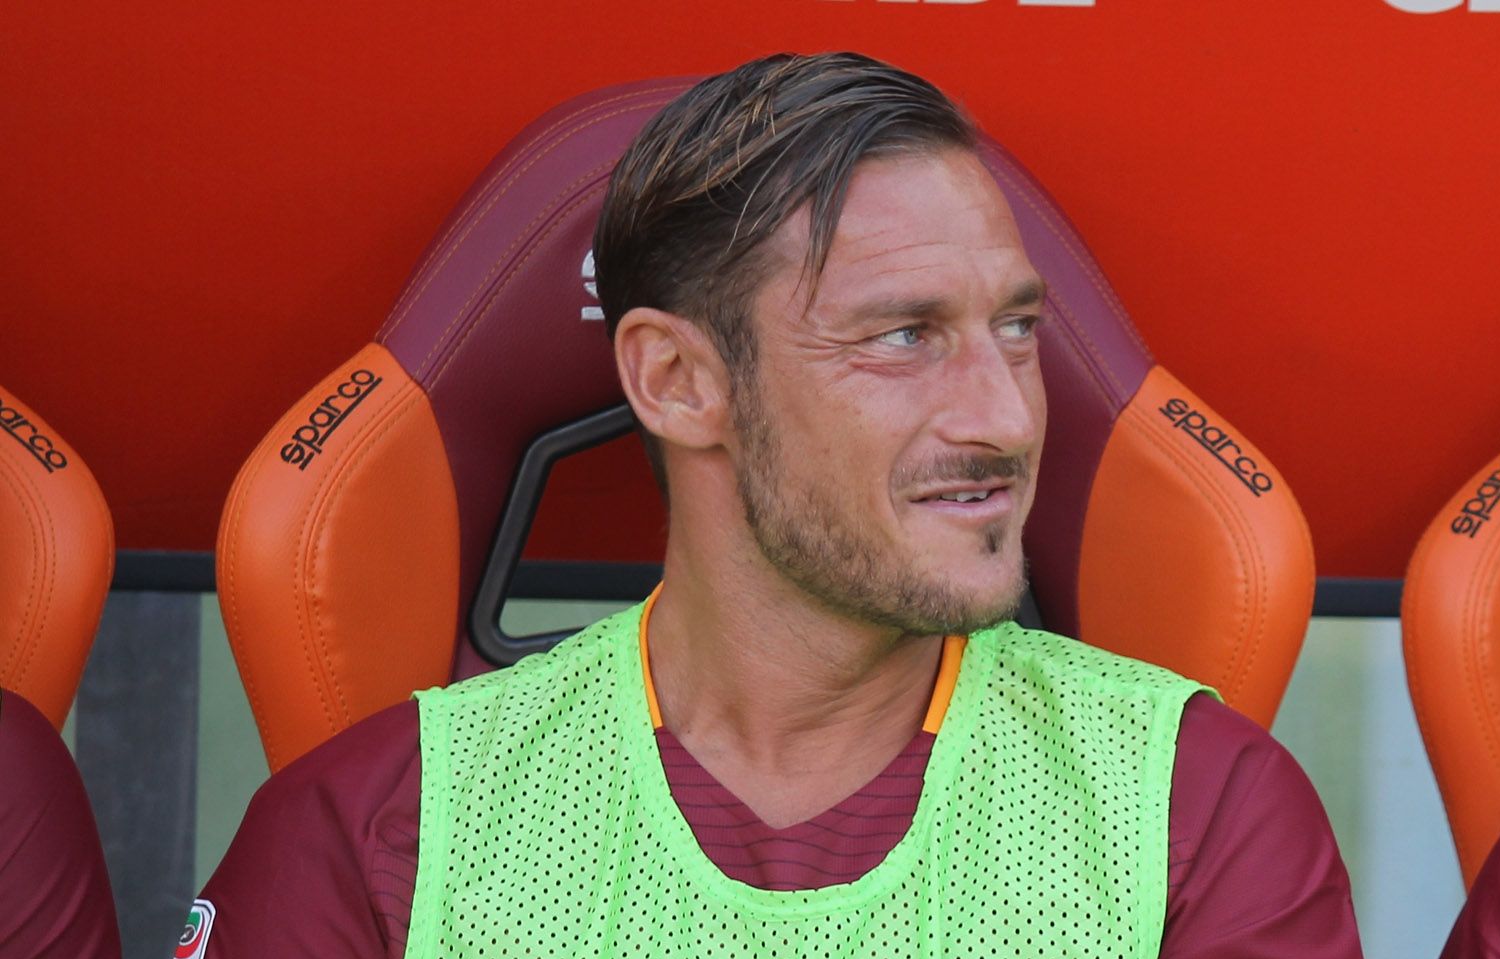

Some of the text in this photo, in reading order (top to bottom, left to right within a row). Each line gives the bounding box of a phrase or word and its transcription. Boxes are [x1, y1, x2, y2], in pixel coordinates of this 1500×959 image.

[0, 404, 67, 472] arco
[279, 368, 383, 471] sparco
[1158, 397, 1273, 497] sparco
